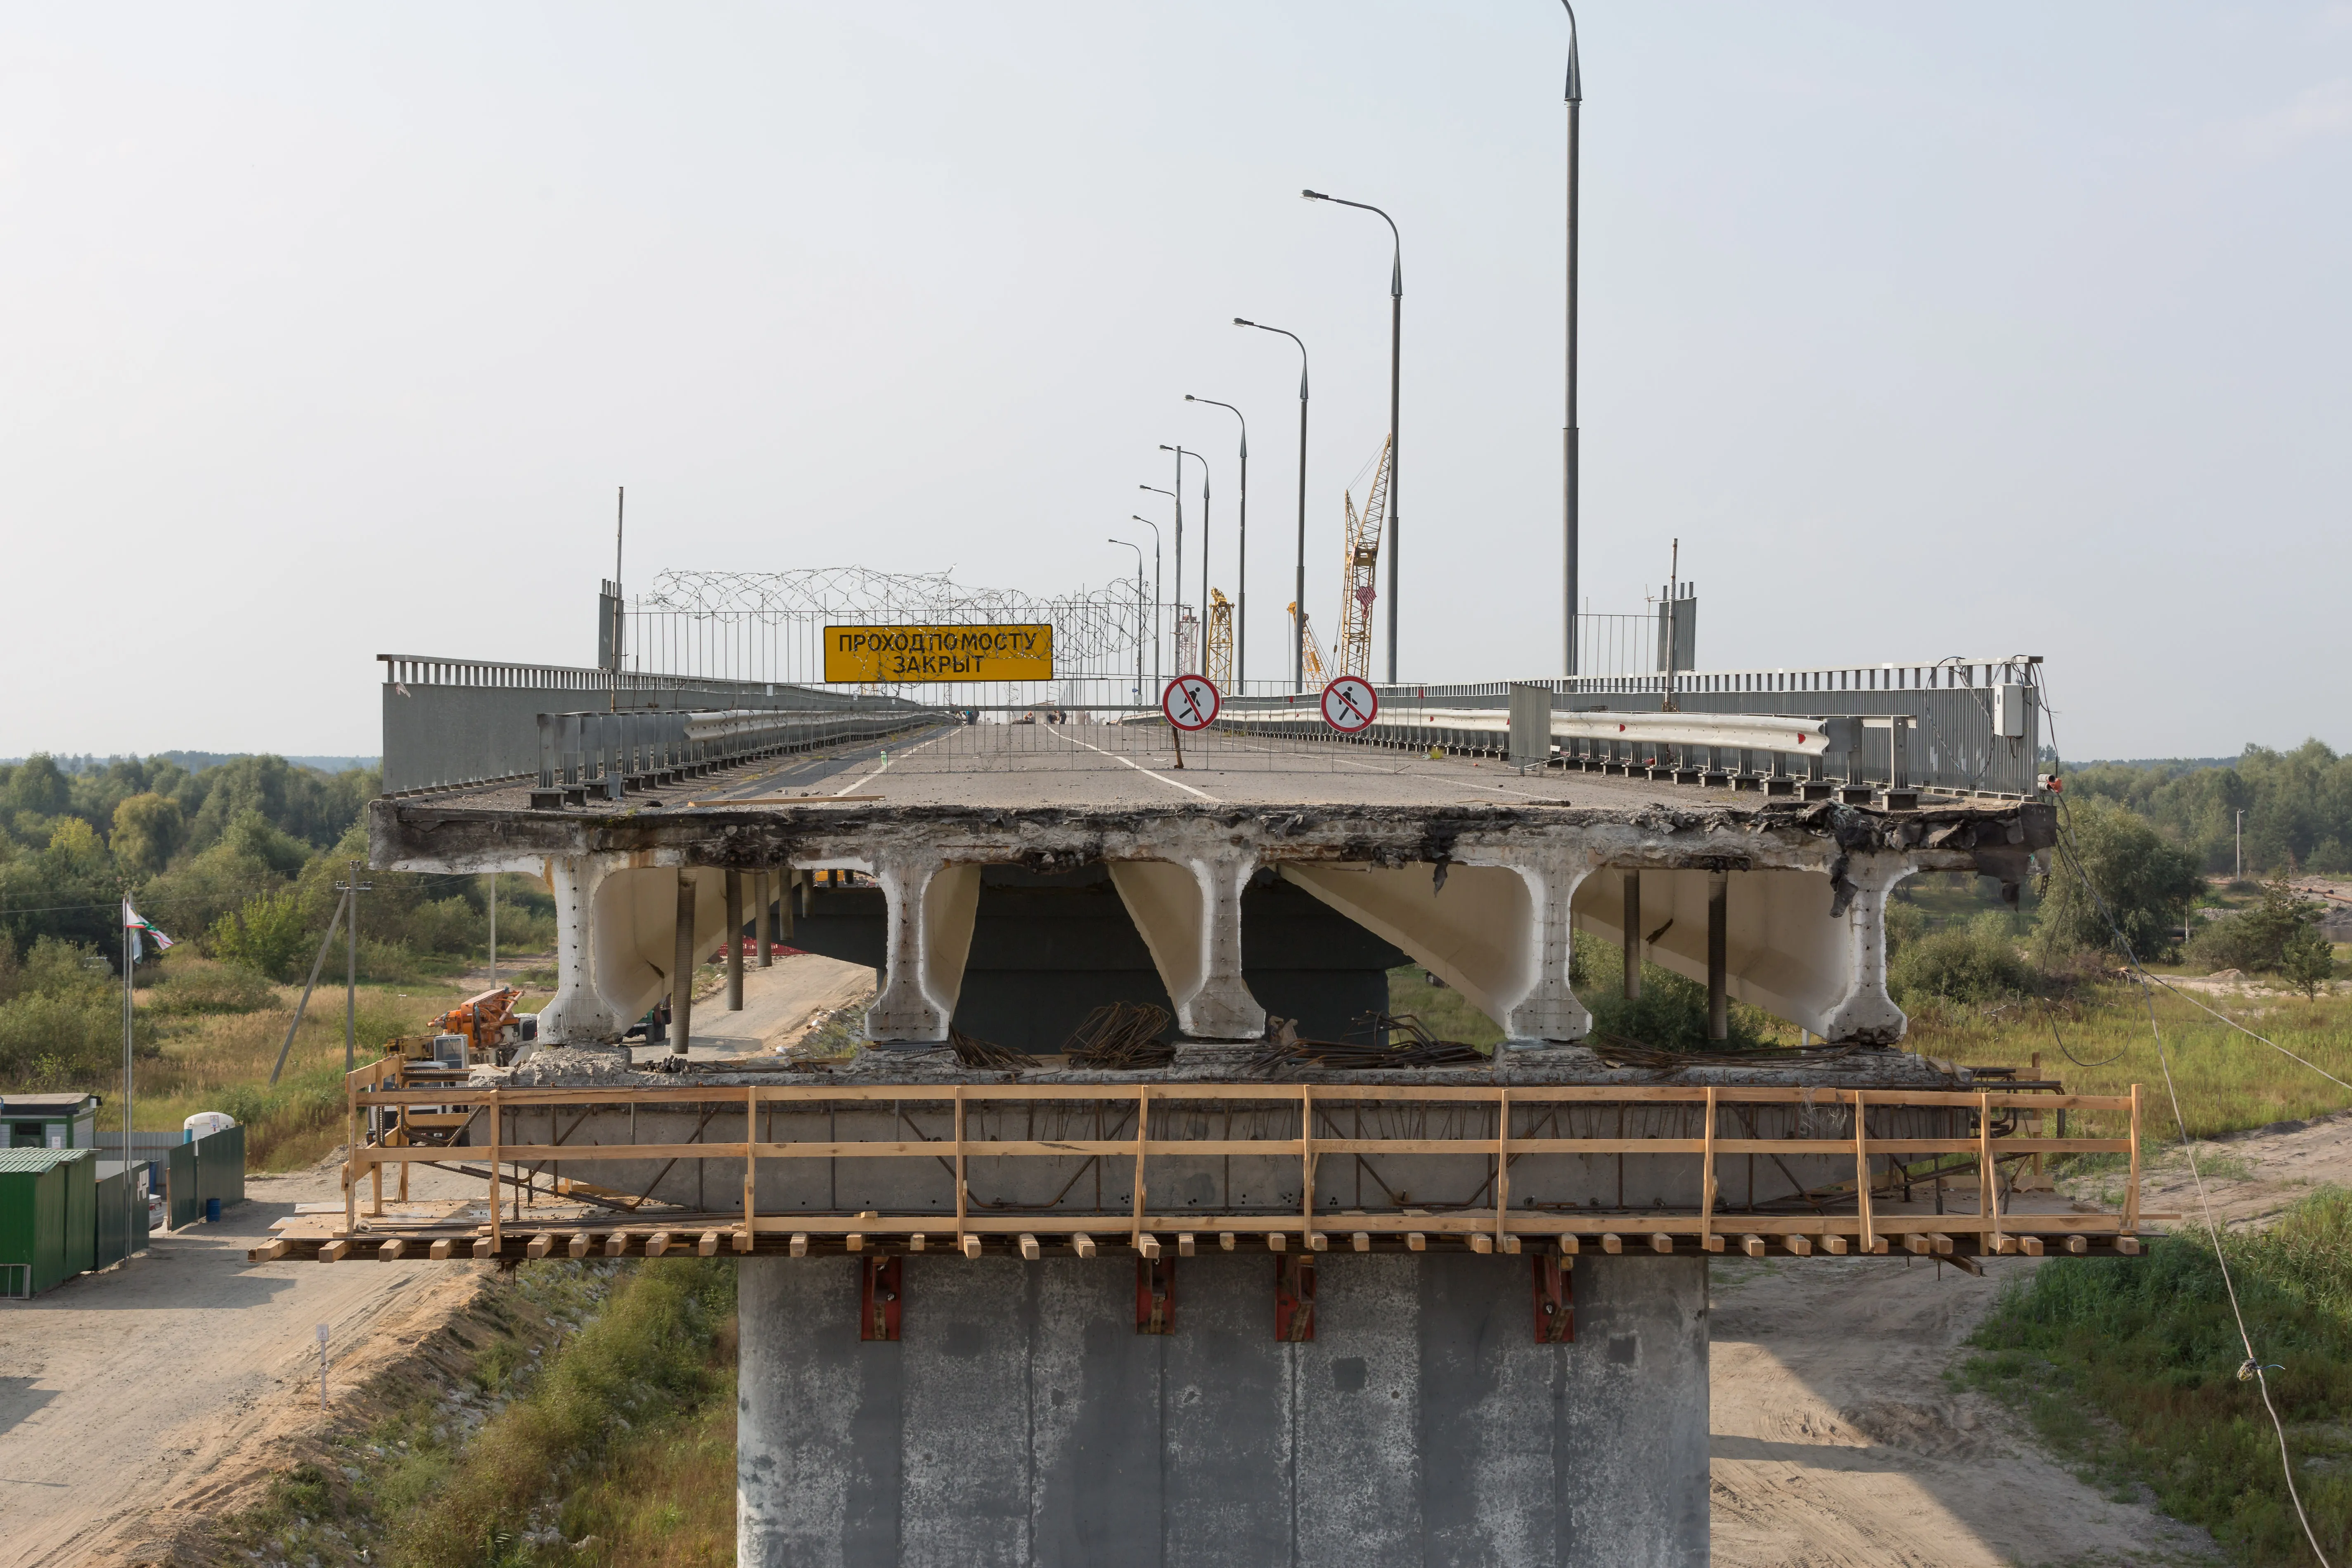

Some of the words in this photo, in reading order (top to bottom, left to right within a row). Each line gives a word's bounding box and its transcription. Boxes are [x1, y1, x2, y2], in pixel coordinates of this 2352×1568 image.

[840, 633, 925, 654] ПРОХОД
[929, 633, 957, 651] ПО
[961, 632, 1037, 651] МОСТУ
[893, 655, 985, 674] ЗАКРЫТ
